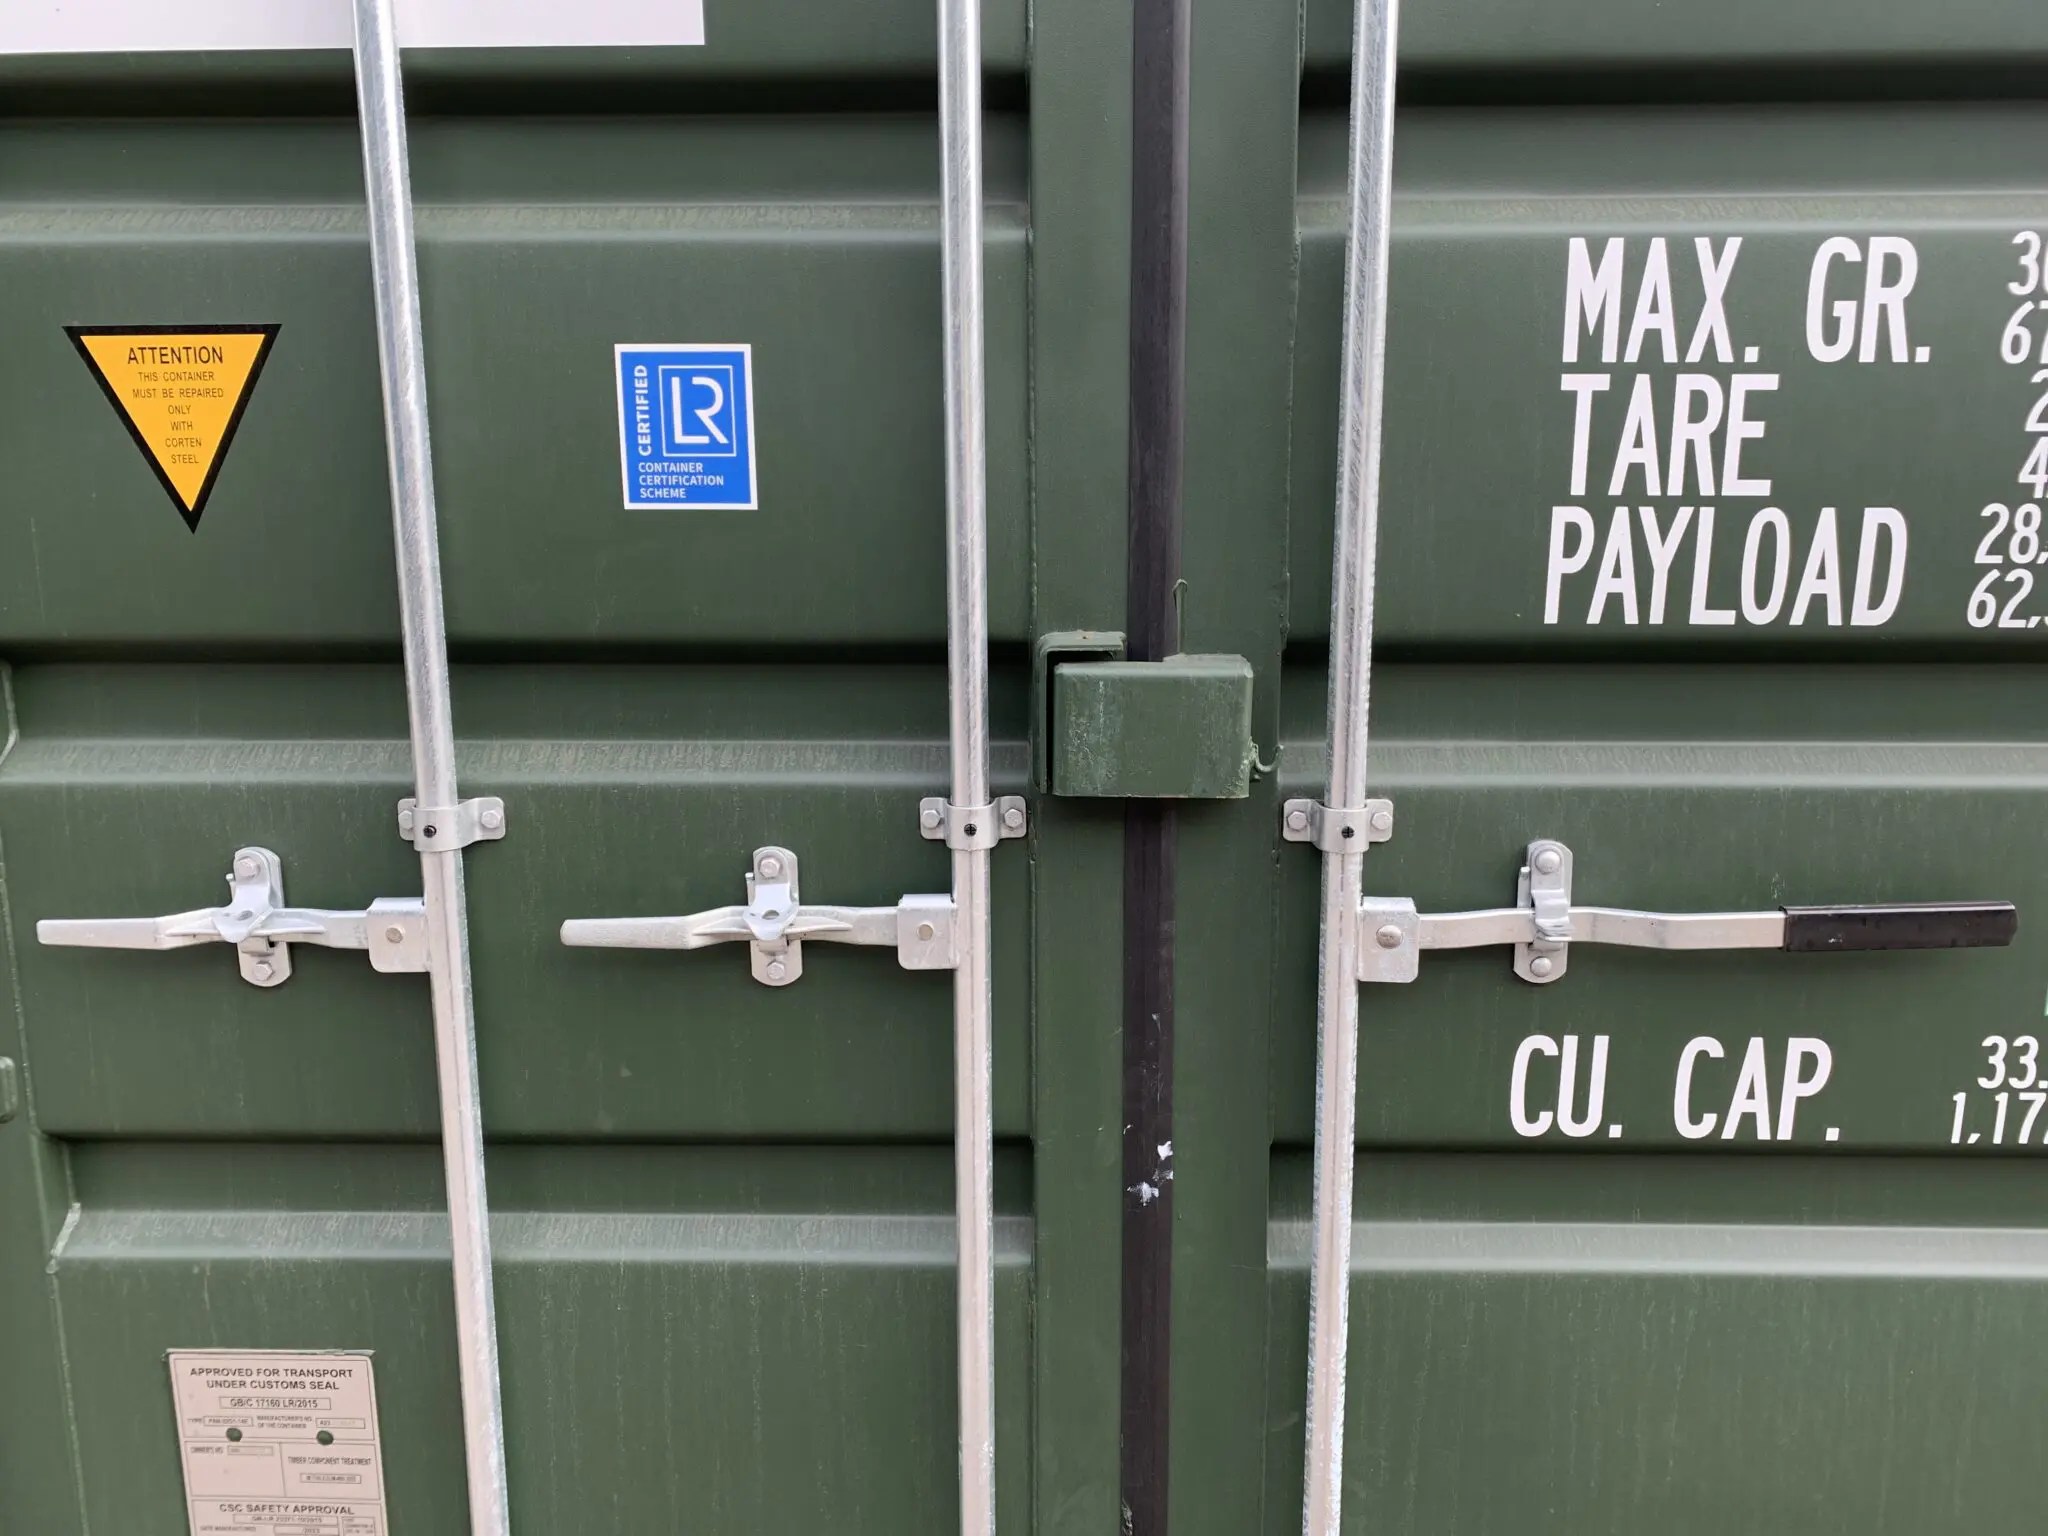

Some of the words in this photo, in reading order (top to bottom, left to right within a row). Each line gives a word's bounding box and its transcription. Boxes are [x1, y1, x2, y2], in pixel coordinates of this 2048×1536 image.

[2007, 231, 2048, 295] 3
[1562, 237, 1760, 363] MAX.
[1805, 237, 1931, 363] GR.
[127, 346, 224, 364] ATTENTION
[138, 372, 158, 382] THIS
[163, 371, 215, 382] CONTAINER
[132, 388, 157, 399] MUST
[162, 388, 175, 399] BE
[179, 388, 224, 398] REPAIRED
[168, 405, 191, 414] ONLY
[634, 365, 652, 457] CERTIFIED
[671, 376, 729, 444] LR
[171, 421, 193, 431] WITH
[1560, 373, 1780, 496] TARE
[165, 438, 202, 447] CORTEN
[171, 454, 199, 464] STEEL
[638, 462, 703, 473] CONTAINER
[2018, 436, 2048, 498] 4
[639, 475, 724, 486] CERTIFICATION
[640, 488, 687, 499] SCHEME
[1543, 505, 1908, 626] PAYLOAD
[1967, 568, 2048, 628] 62,
[1509, 1035, 1623, 1139] CU.
[1674, 1036, 1840, 1141] CAP.
[1951, 1092, 2048, 1144] 1,17
[190, 1368, 253, 1377] APPROVED
[256, 1368, 280, 1377] FOR
[284, 1369, 353, 1378] TRANSPORT
[206, 1380, 247, 1389] UNDER
[250, 1380, 306, 1389] CUSTOMS
[310, 1381, 340, 1390] SEAL
[219, 1503, 242, 1512] CSC
[246, 1504, 289, 1513] SAFETY
[293, 1505, 355, 1514] APPROVAL
